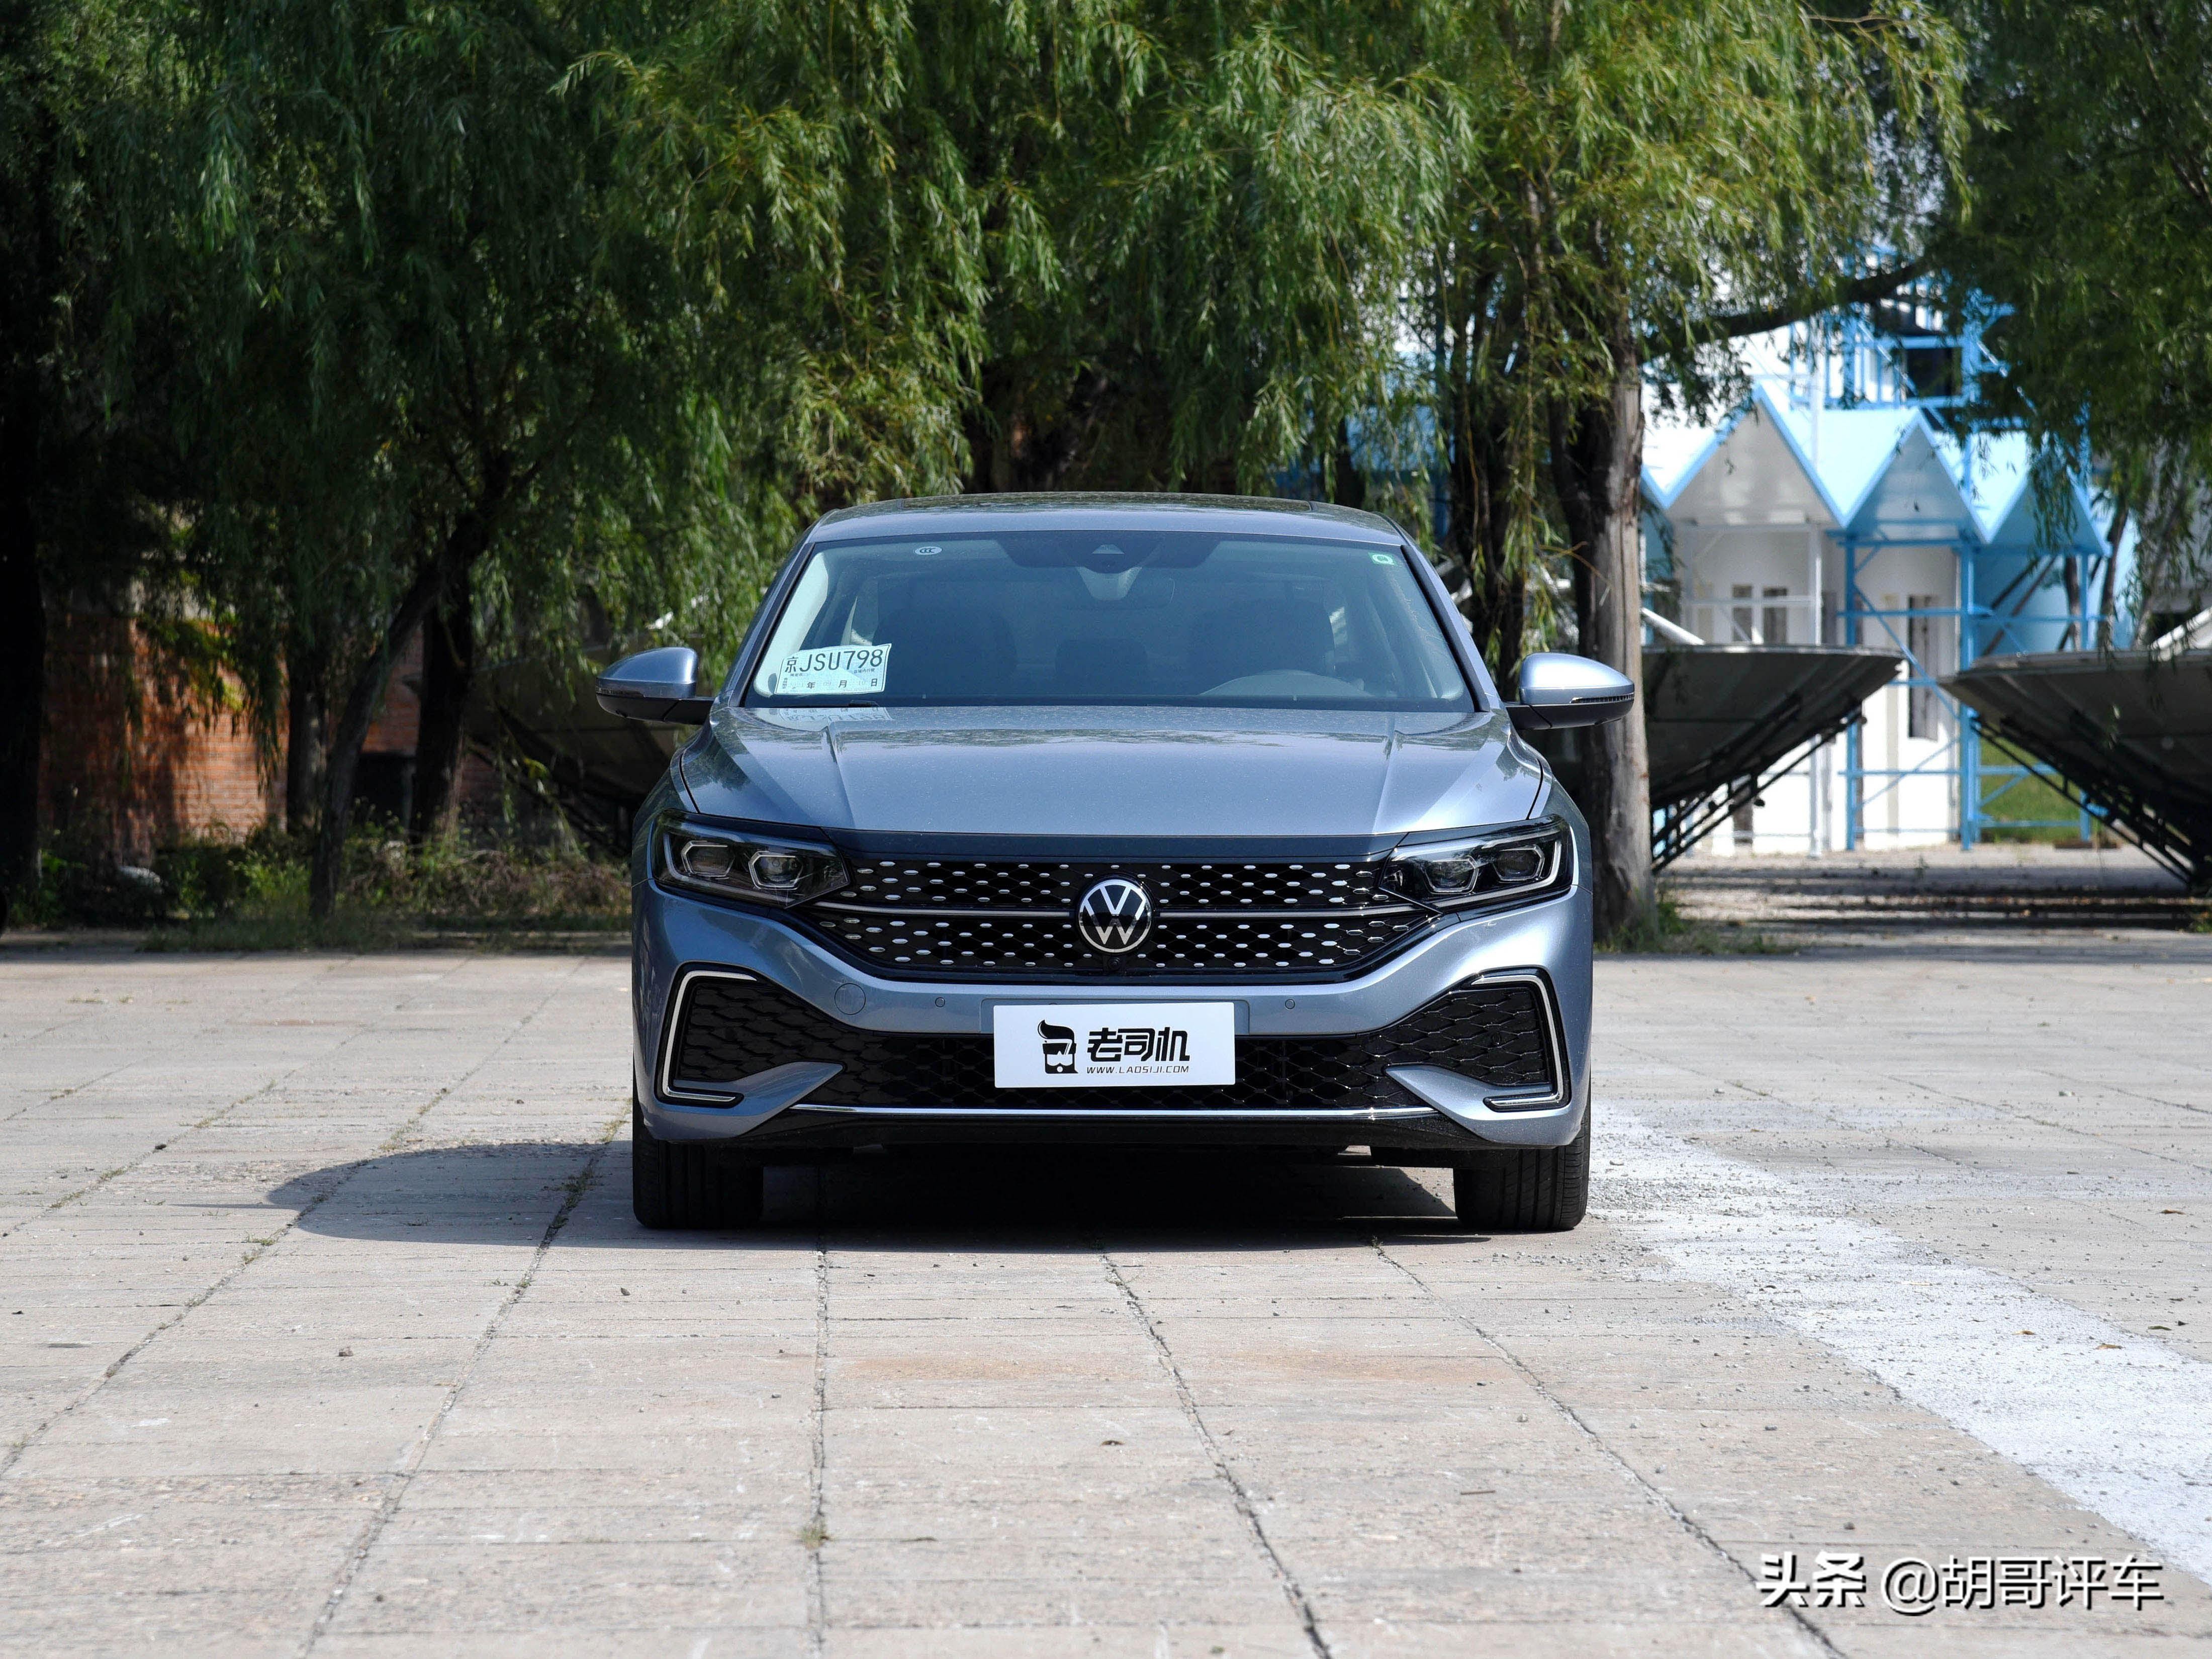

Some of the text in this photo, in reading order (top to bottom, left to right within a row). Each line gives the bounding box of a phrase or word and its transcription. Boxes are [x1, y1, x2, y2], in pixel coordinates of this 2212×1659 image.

[785, 649, 883, 673] 京JSU798
[871, 678, 878, 687] 日
[1087, 1027, 1190, 1062] 老司机
[1086, 1065, 1189, 1074] WWW.LAOSIJI.COM
